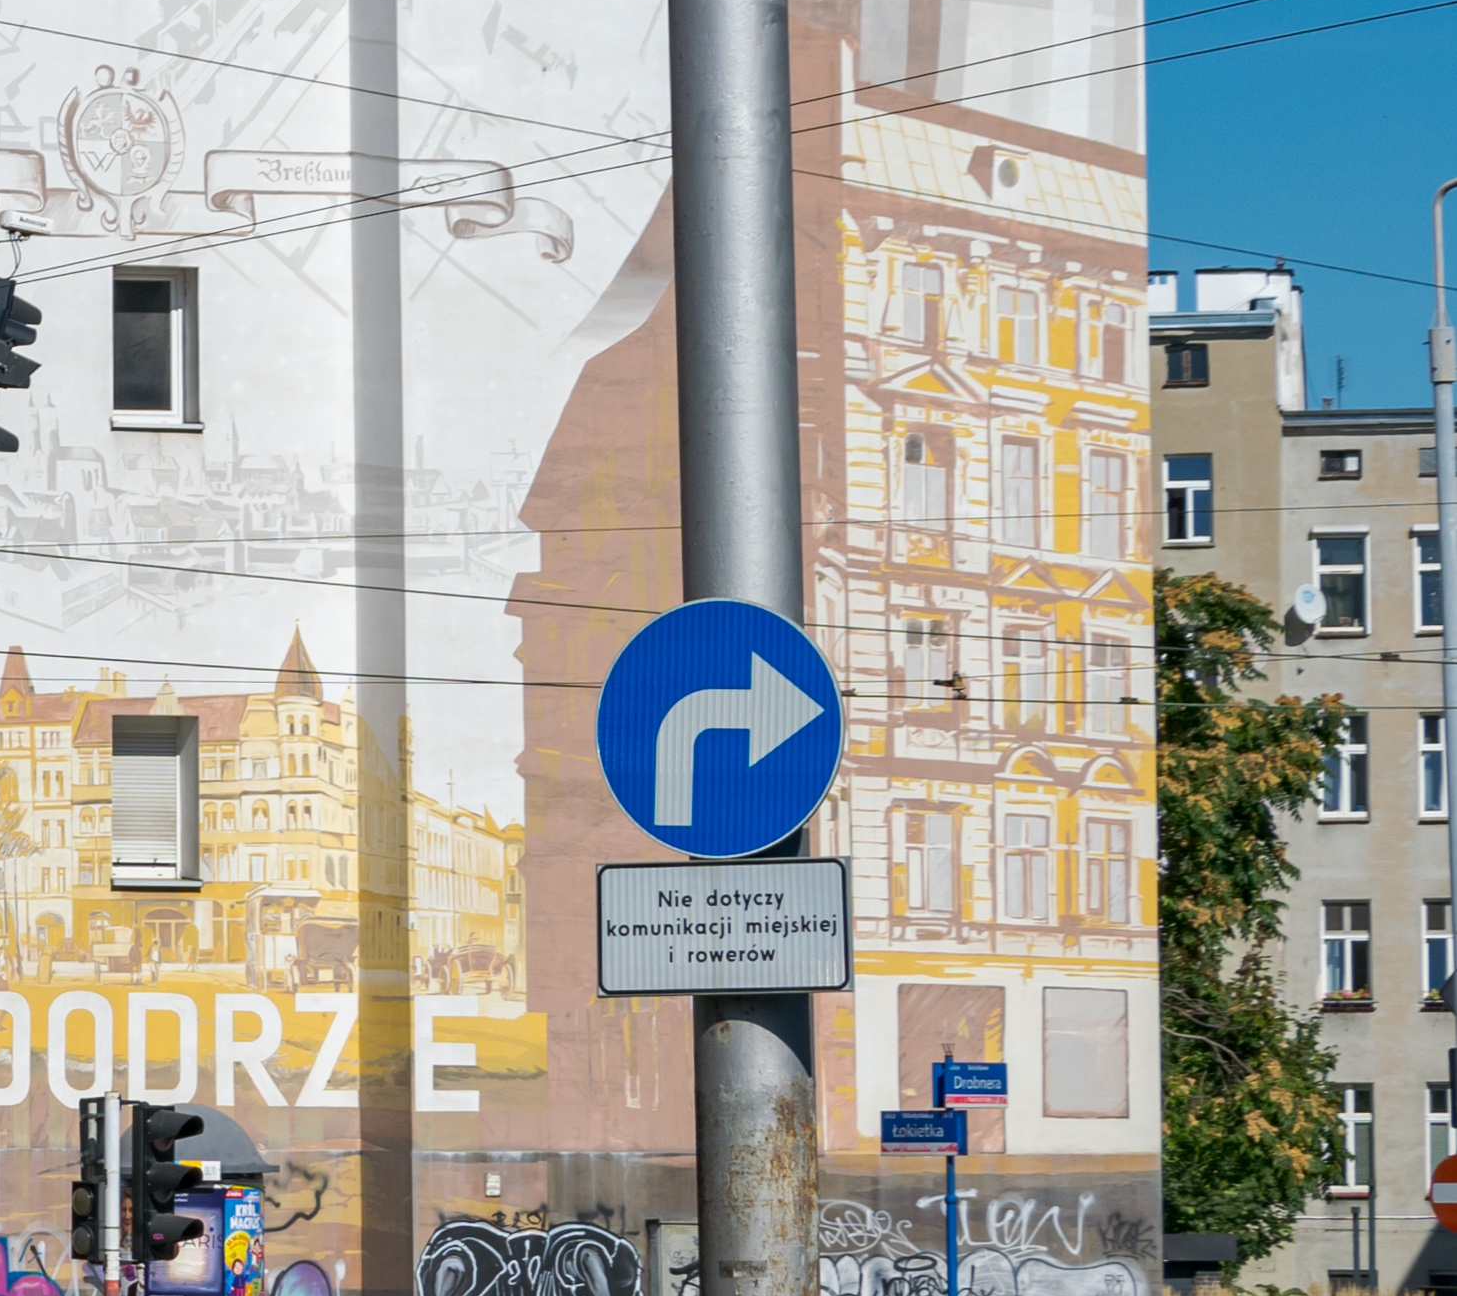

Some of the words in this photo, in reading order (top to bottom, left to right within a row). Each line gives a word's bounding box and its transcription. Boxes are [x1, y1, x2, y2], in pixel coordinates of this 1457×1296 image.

[657, 890, 694, 908] Nie
[706, 889, 785, 912] dotyczy
[606, 916, 733, 939] komunikacji
[746, 915, 838, 937] miejskiej
[669, 945, 674, 963] i
[687, 944, 776, 963] rowerów
[892, 1123, 945, 1138] Łokietka
